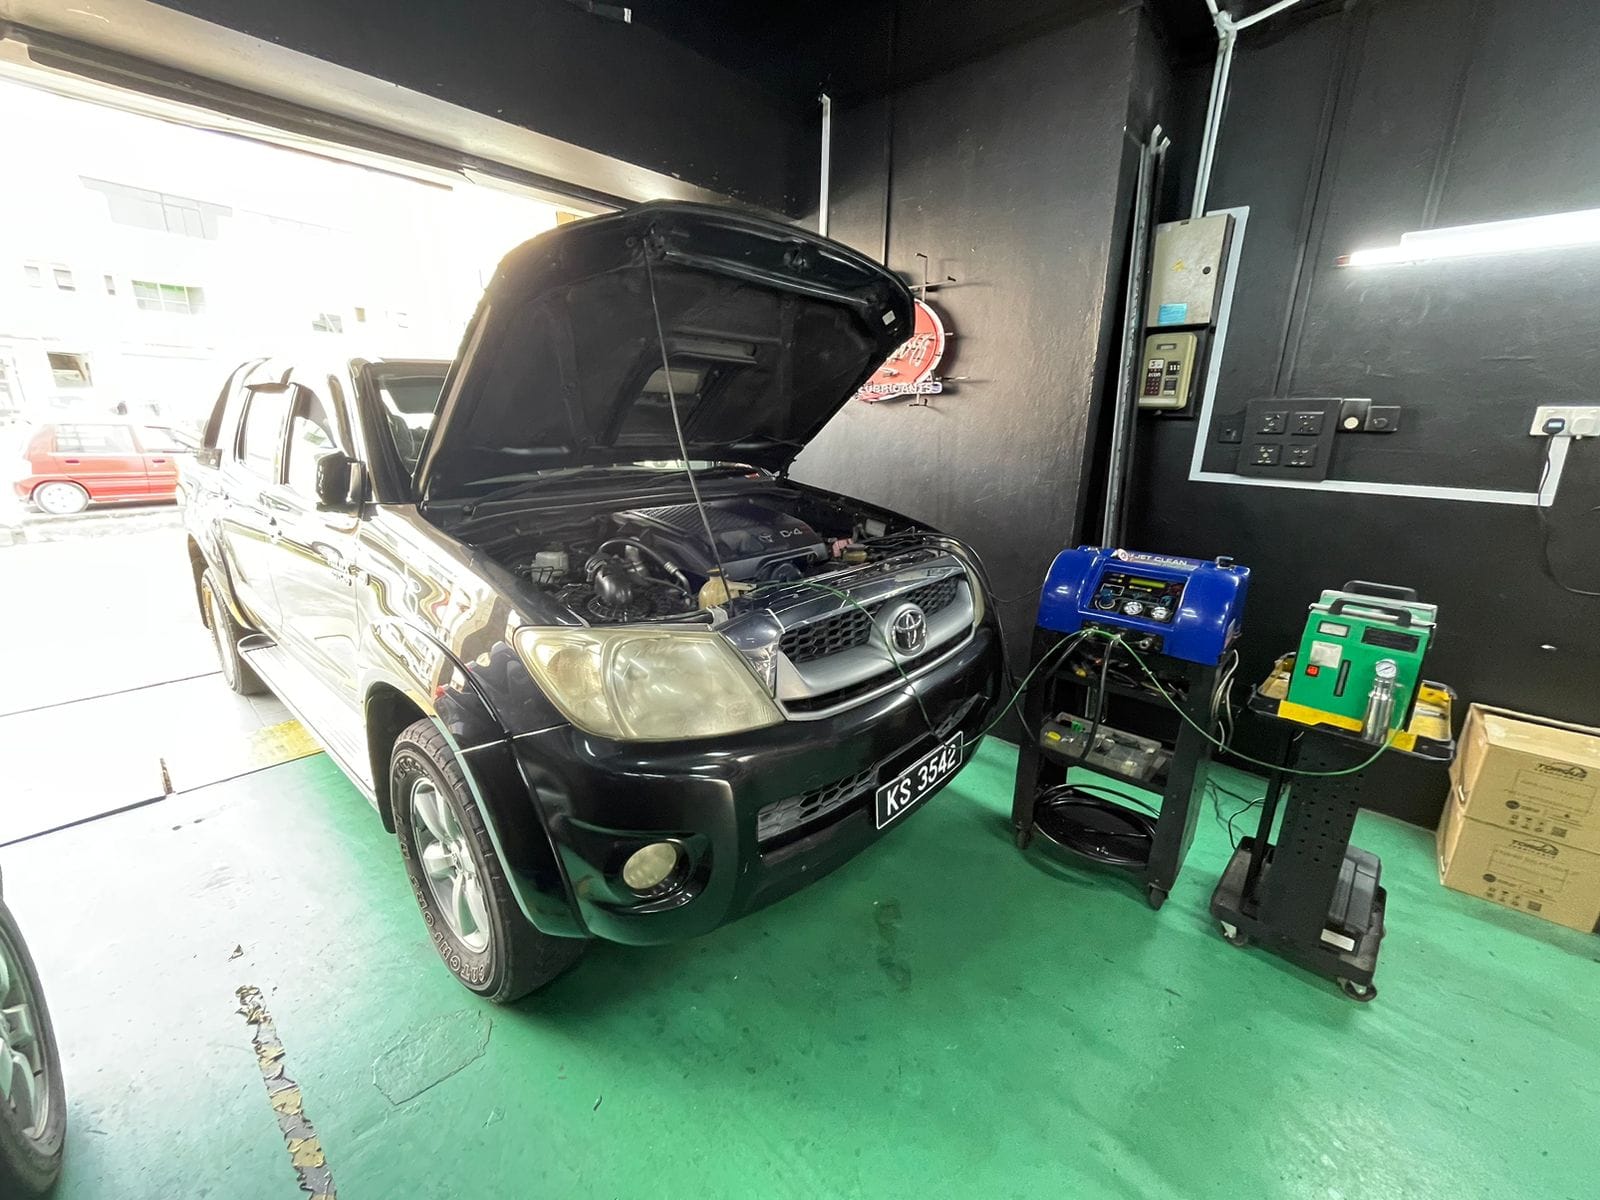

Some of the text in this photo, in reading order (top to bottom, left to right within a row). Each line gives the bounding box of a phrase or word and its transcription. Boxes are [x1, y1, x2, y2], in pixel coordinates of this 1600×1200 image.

[1154, 556, 1188, 566] CLEAN
[887, 743, 956, 816] KS 3542
